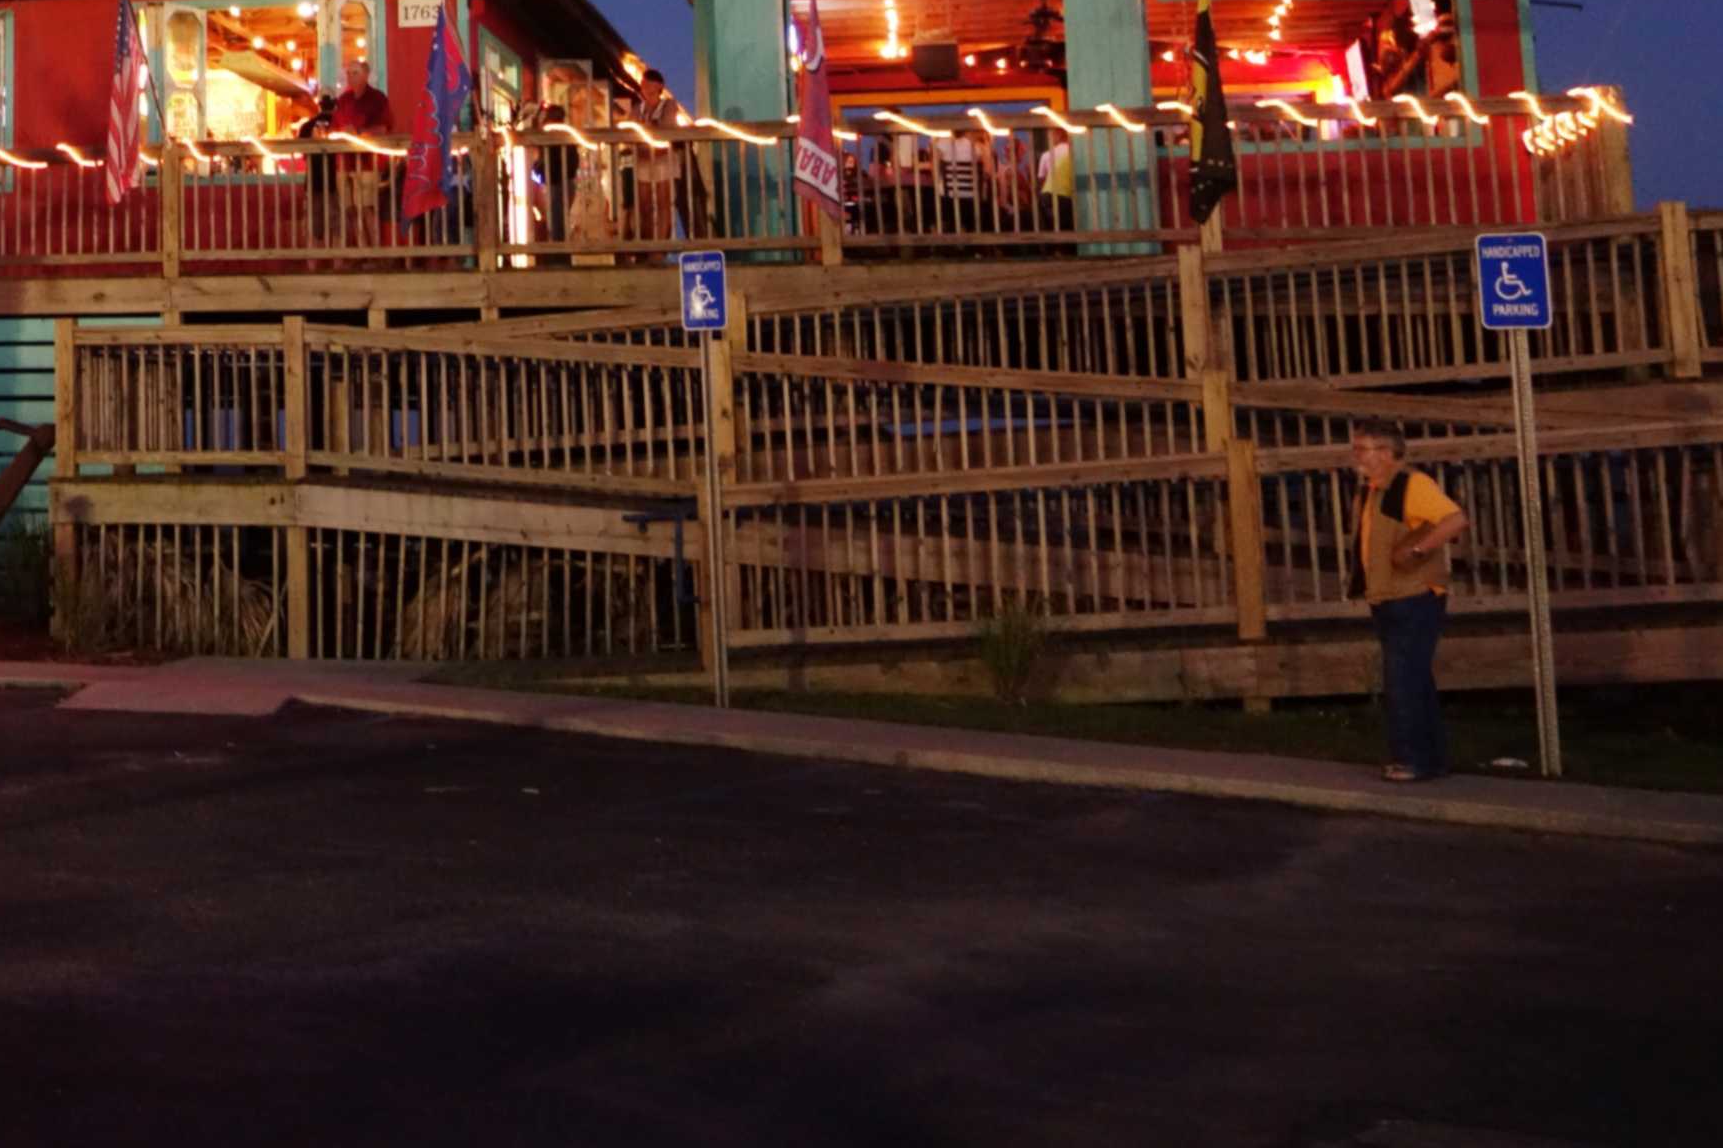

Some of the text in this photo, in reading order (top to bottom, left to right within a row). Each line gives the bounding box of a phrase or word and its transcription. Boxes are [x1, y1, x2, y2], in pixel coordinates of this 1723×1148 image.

[1481, 245, 1540, 259] HANDICAPPED
[689, 308, 719, 320] PKING
[1493, 303, 1539, 316] PARKING
